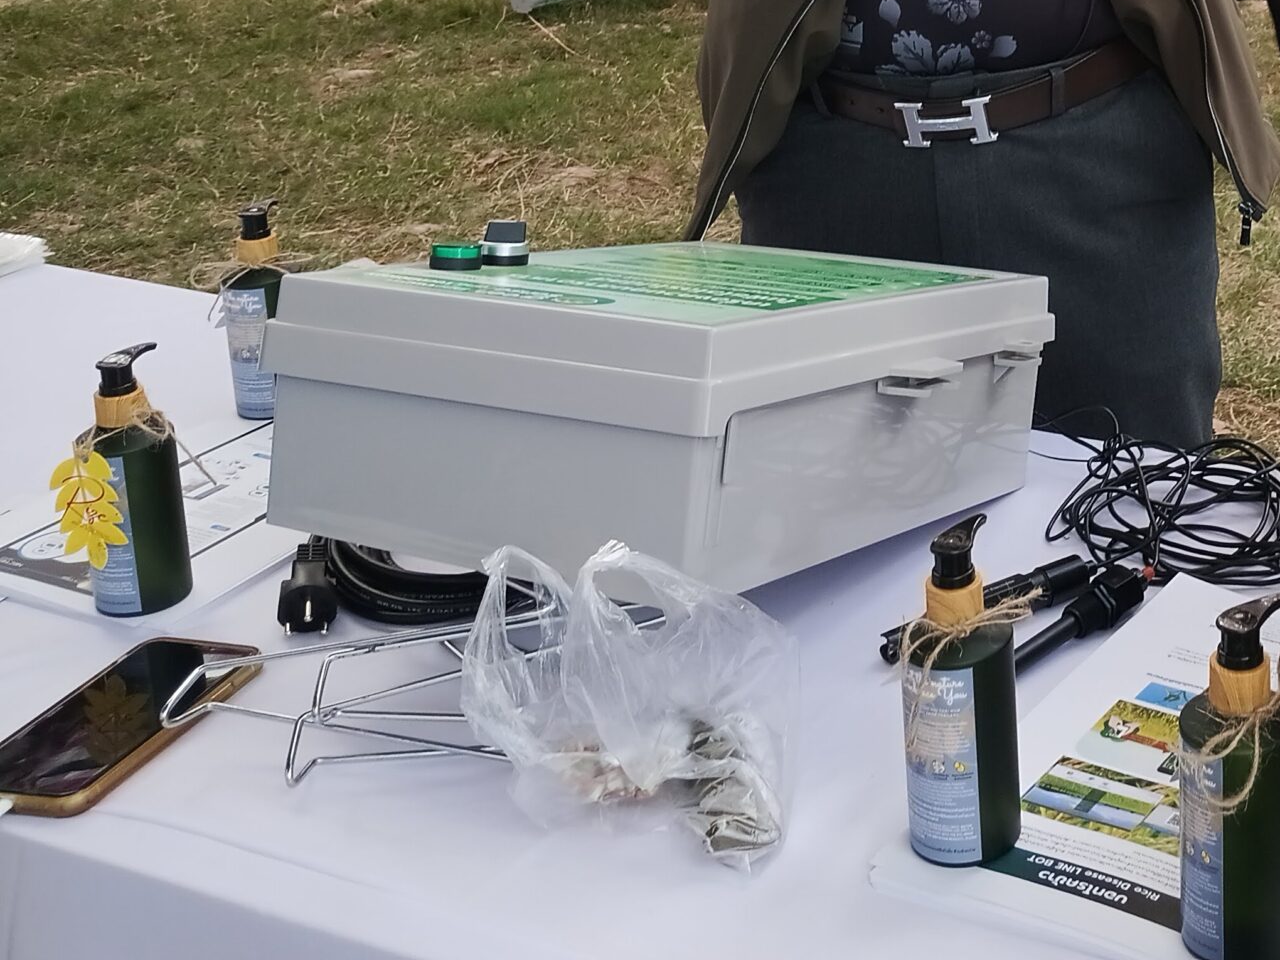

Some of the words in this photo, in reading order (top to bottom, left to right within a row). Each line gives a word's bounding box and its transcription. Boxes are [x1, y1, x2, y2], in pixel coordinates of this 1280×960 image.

[1027, 854, 1054, 867] BOT
[1055, 862, 1082, 875] LINE
[1038, 870, 1128, 904] บอกโรคข้าว
[1084, 870, 1131, 891] Disease
[1133, 886, 1161, 902] Rice
